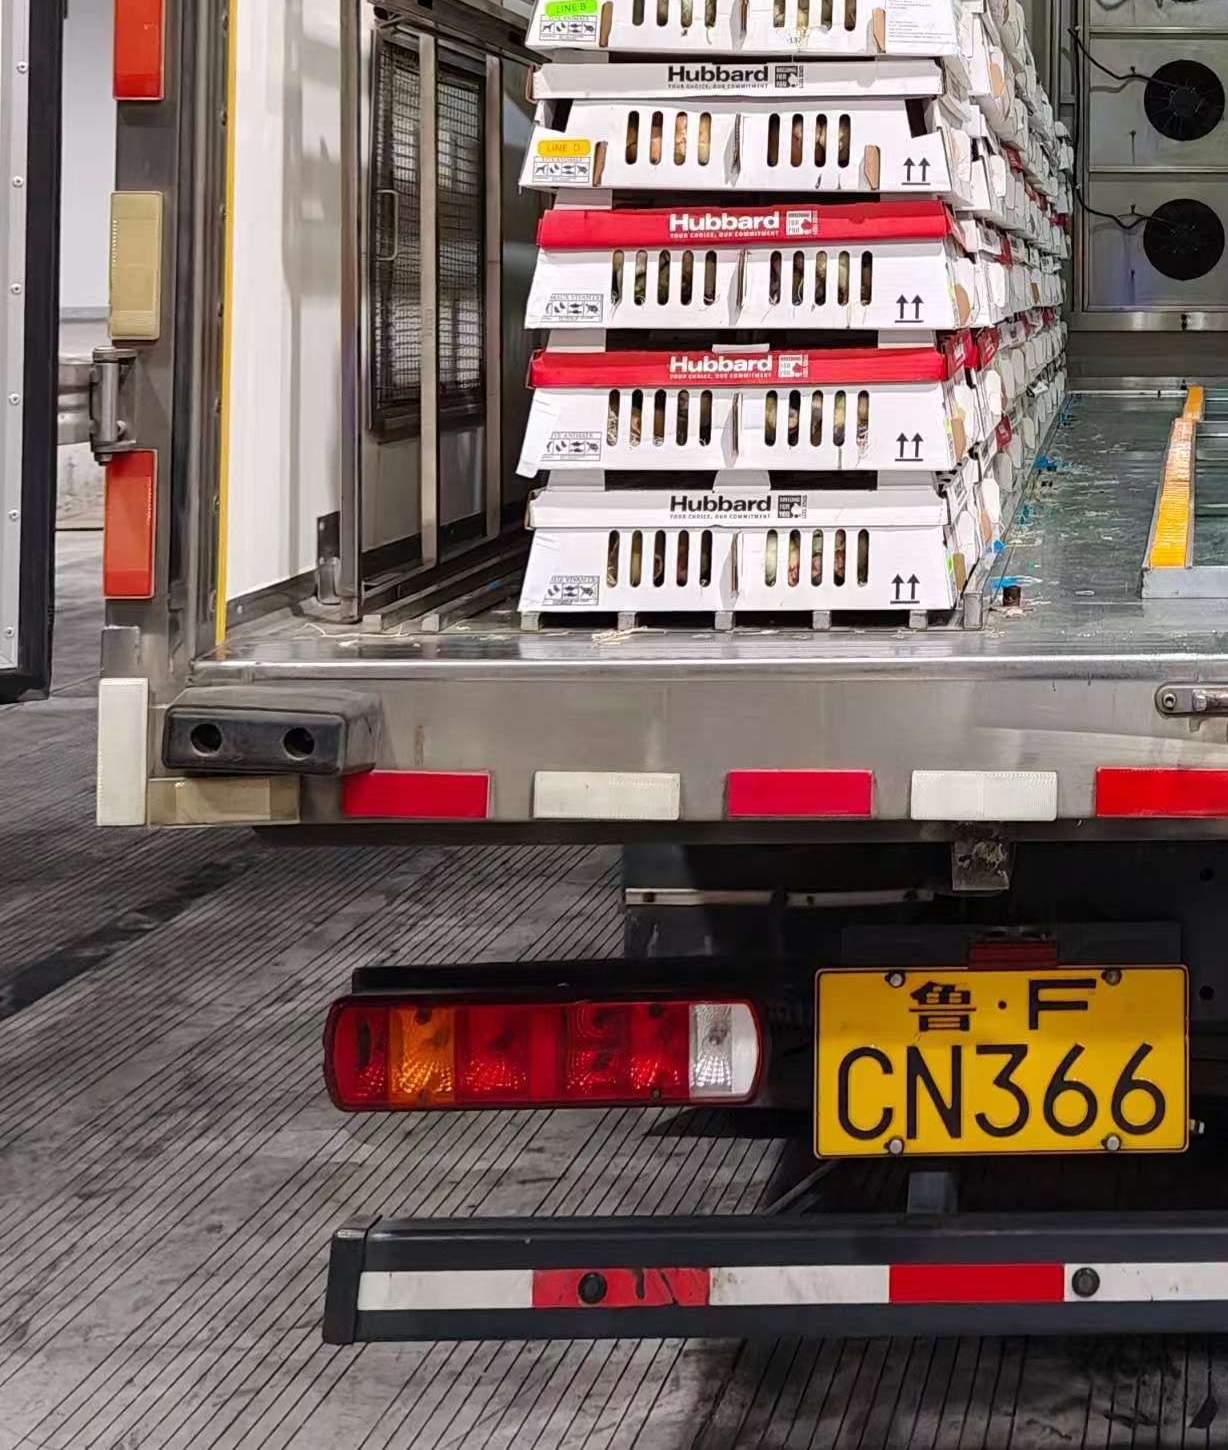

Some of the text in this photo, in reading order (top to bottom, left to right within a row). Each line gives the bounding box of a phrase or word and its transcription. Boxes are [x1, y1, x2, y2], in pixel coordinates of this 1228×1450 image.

[556, 5, 577, 14] LINE
[668, 65, 769, 82] Hubbard
[669, 211, 779, 232] Hubbard
[669, 355, 772, 373] Hubbard
[670, 495, 771, 512] Hubbard
[837, 1042, 1166, 1140] CN366
